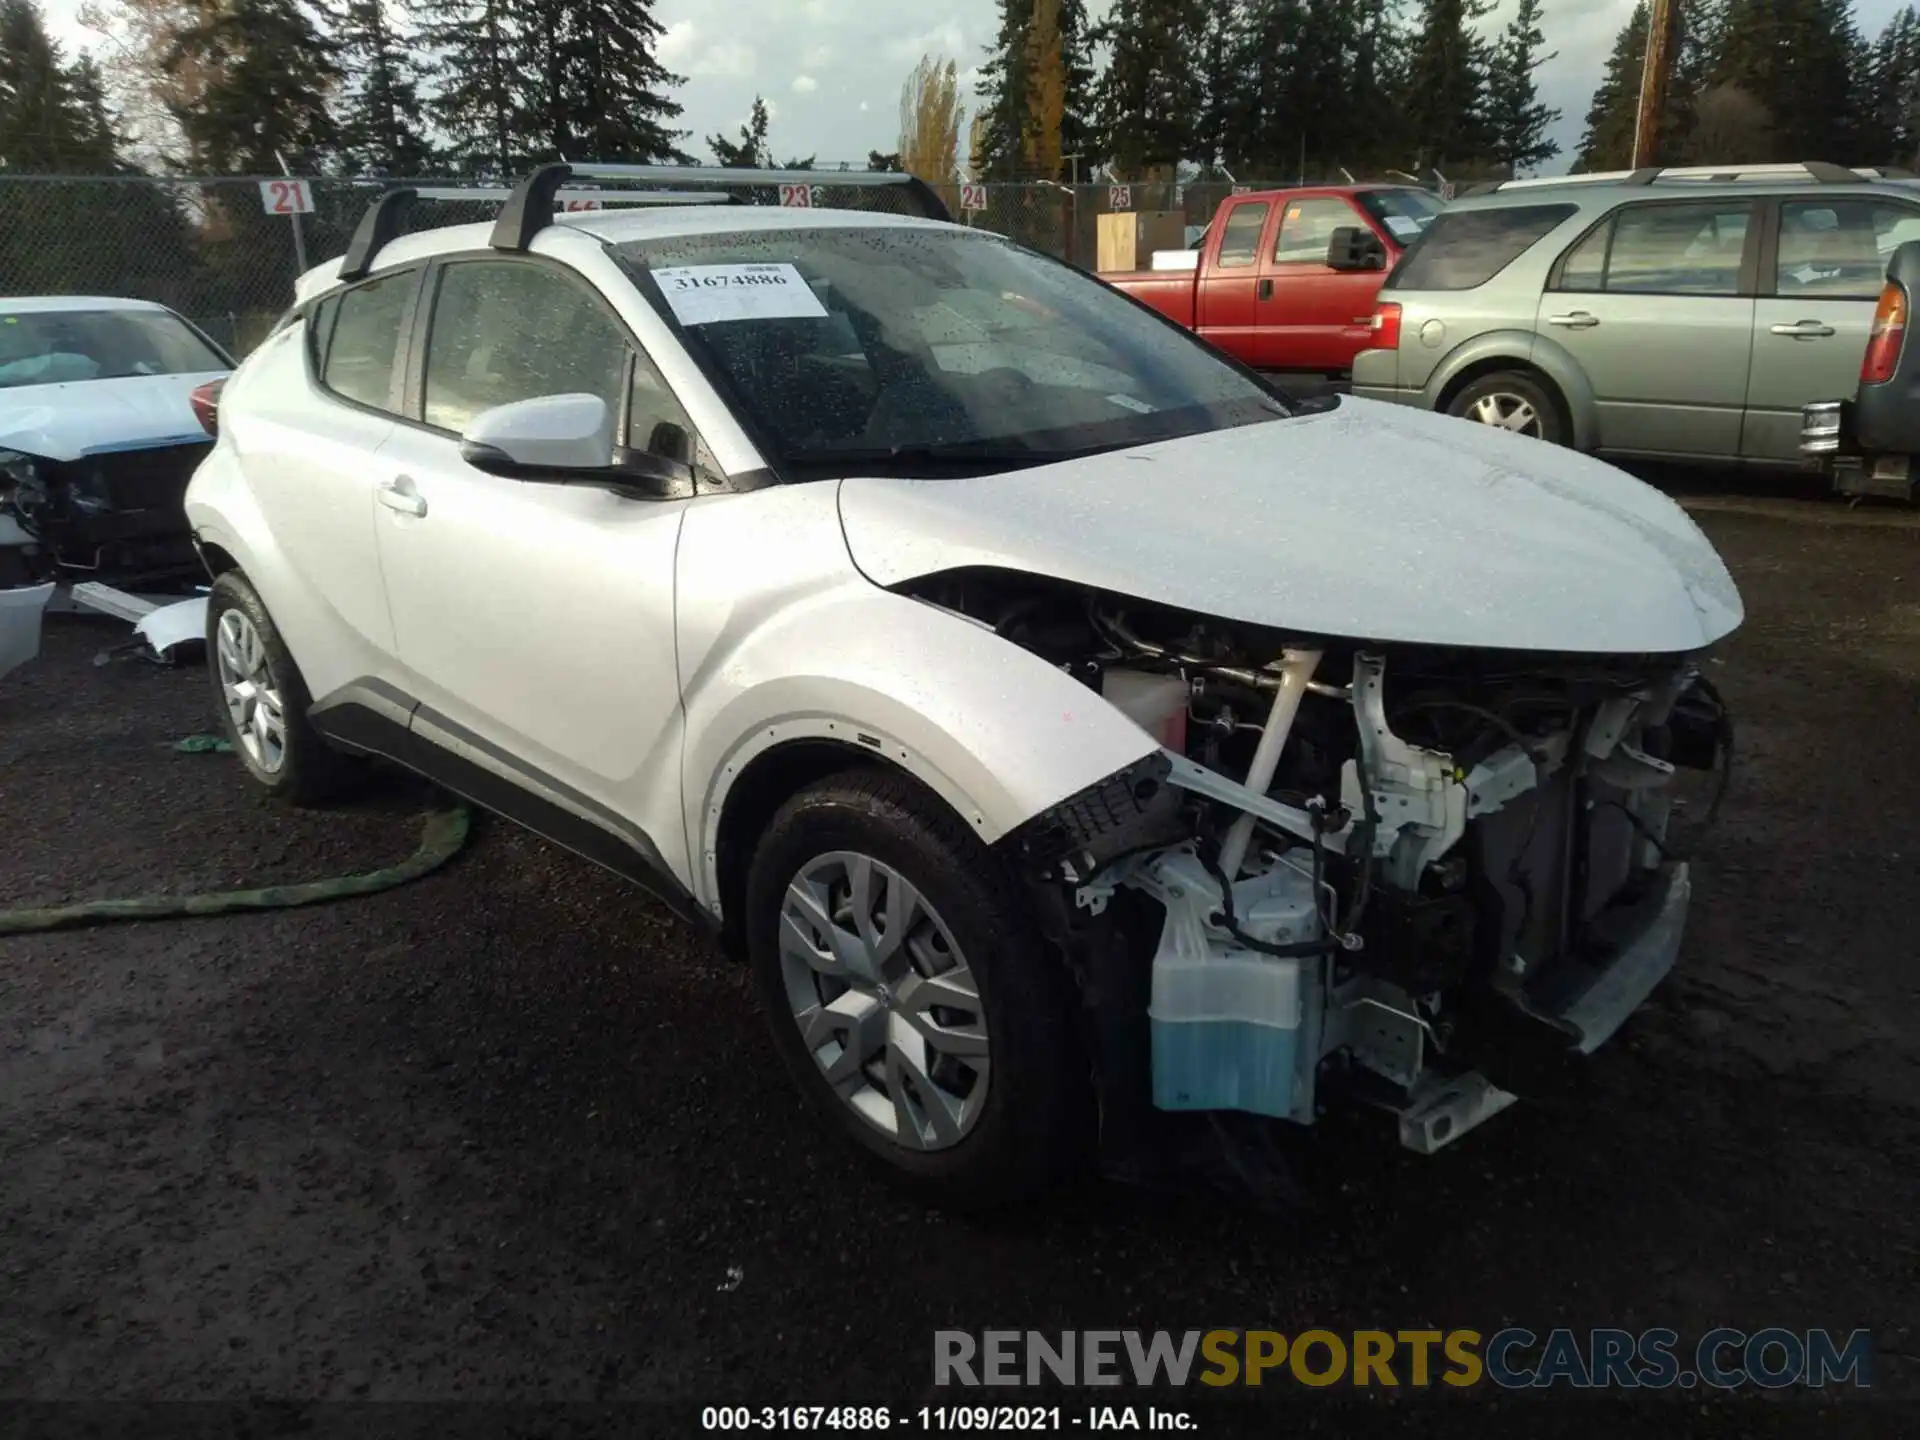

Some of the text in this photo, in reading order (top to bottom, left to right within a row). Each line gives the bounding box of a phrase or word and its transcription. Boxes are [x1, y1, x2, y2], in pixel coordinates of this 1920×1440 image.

[270, 182, 305, 212] 21
[782, 186, 809, 207] 23
[963, 186, 984, 208] 24
[1112, 187, 1129, 206] 25
[674, 274, 788, 290] 31674886
